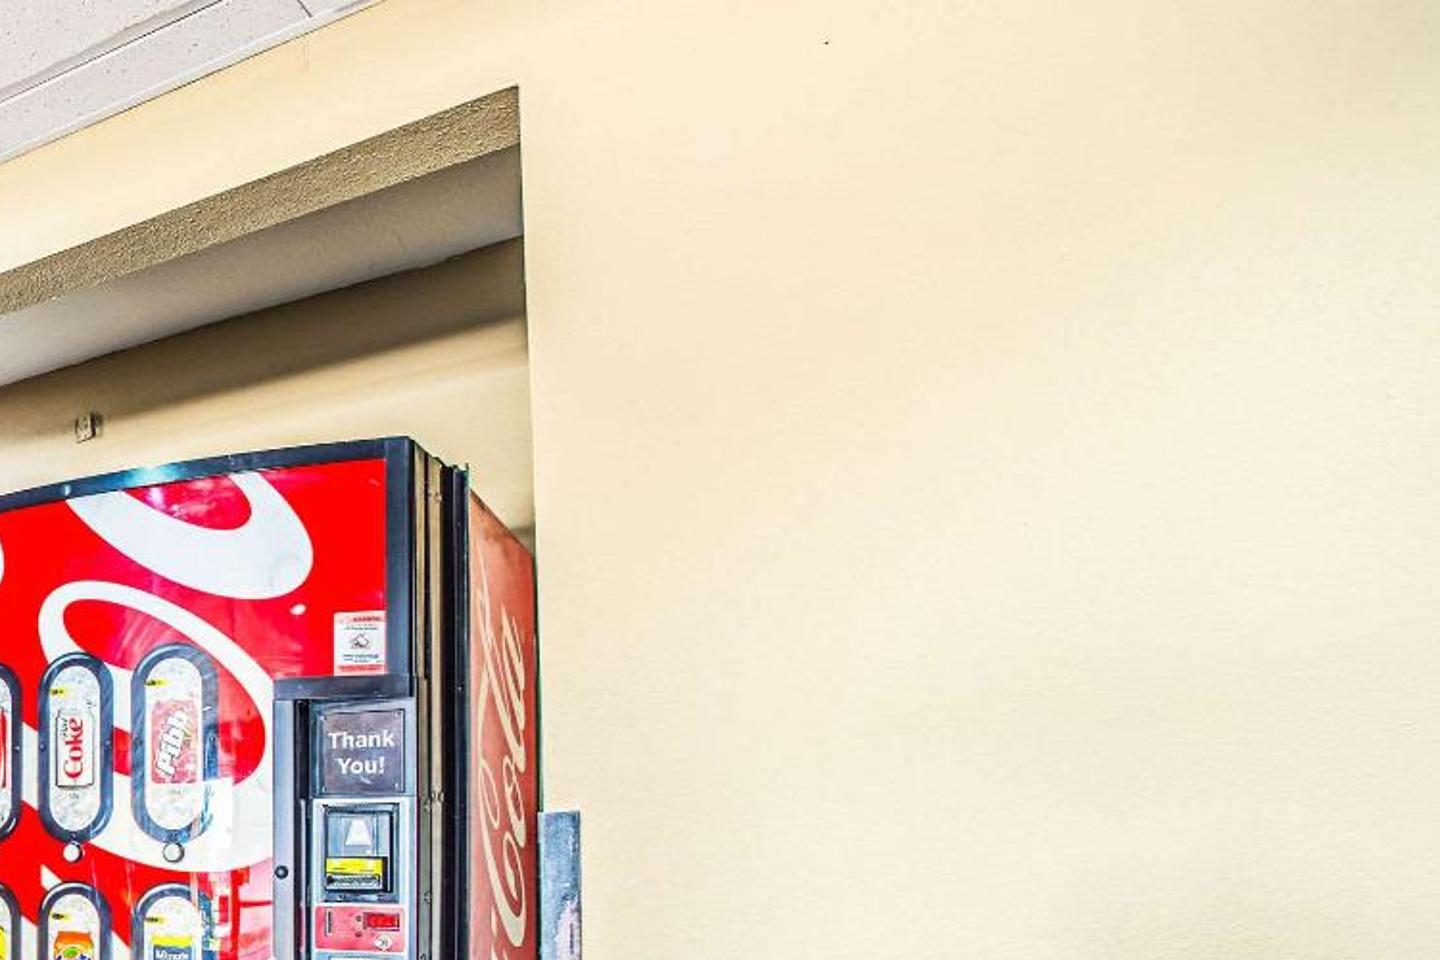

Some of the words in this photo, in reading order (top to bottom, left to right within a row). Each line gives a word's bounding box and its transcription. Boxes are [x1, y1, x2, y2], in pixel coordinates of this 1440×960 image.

[63, 717, 84, 779] Coke
[328, 730, 395, 750] Thank
[337, 756, 385, 775] You!
